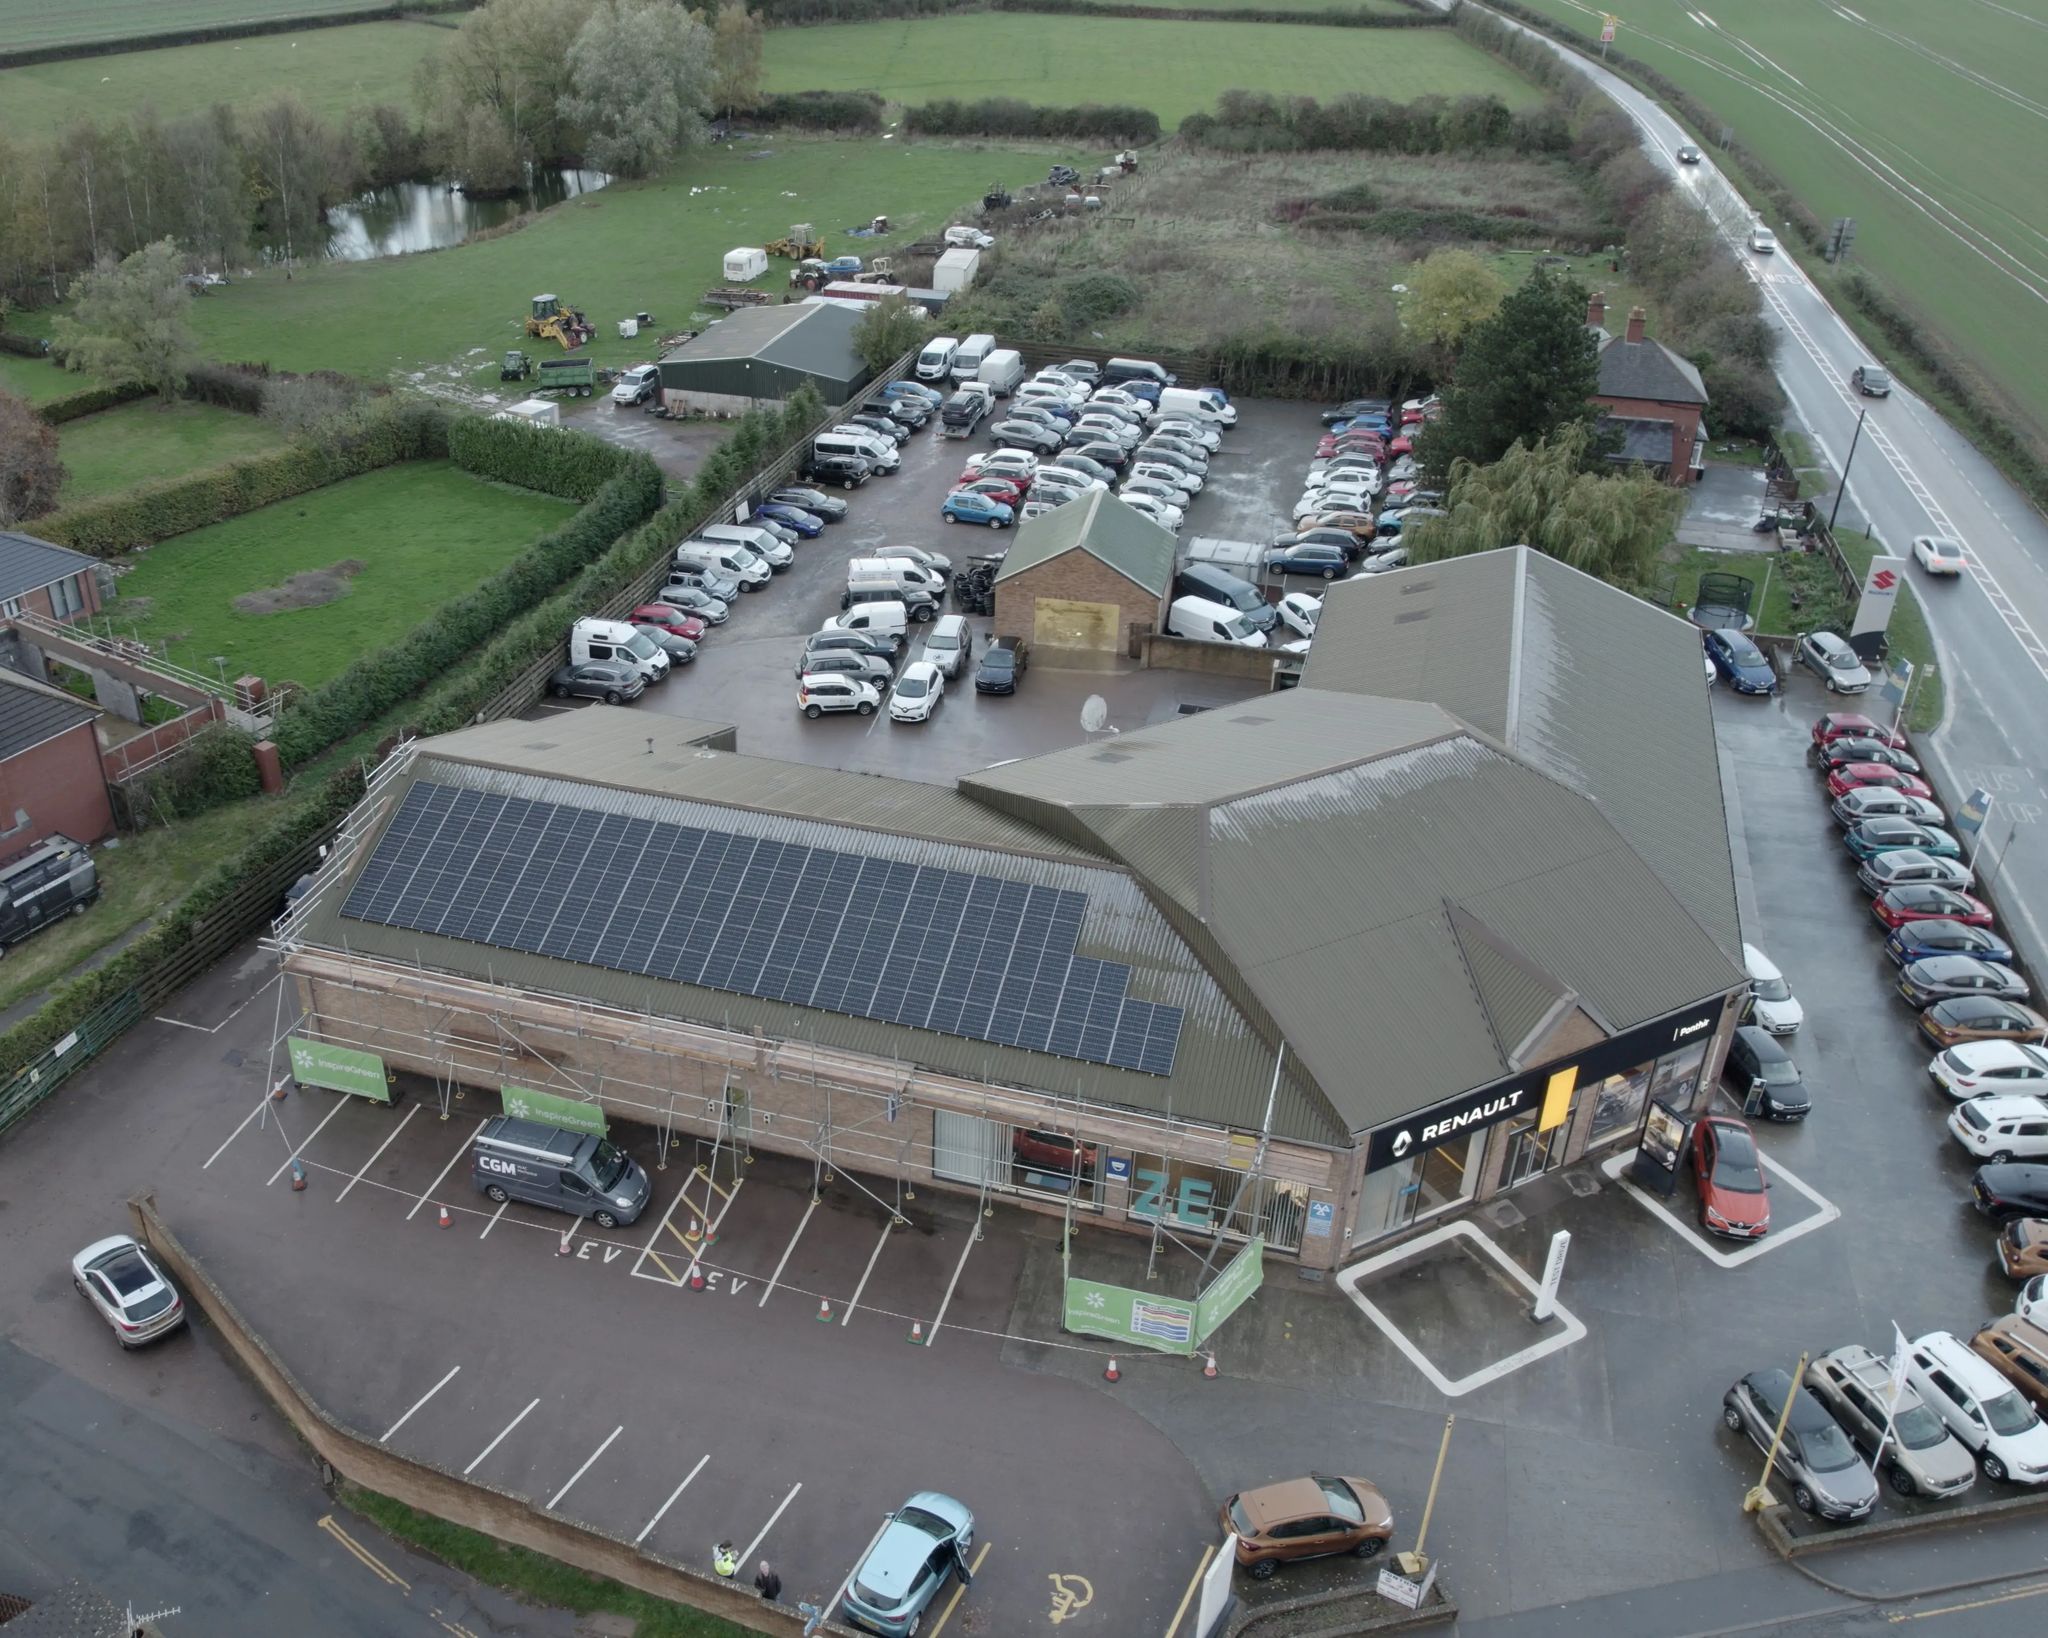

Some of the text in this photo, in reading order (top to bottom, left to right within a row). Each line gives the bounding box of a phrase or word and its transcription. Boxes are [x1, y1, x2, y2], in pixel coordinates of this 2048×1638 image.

[1963, 769, 2020, 793] BUS
[1991, 800, 2042, 825] TOP
[1679, 1018, 1710, 1037] Ponthir
[535, 1108, 601, 1129] InspireGreen
[1421, 1090, 1523, 1142] RENAULT
[479, 1156, 516, 1176] CGM
[576, 1241, 622, 1264] EV
